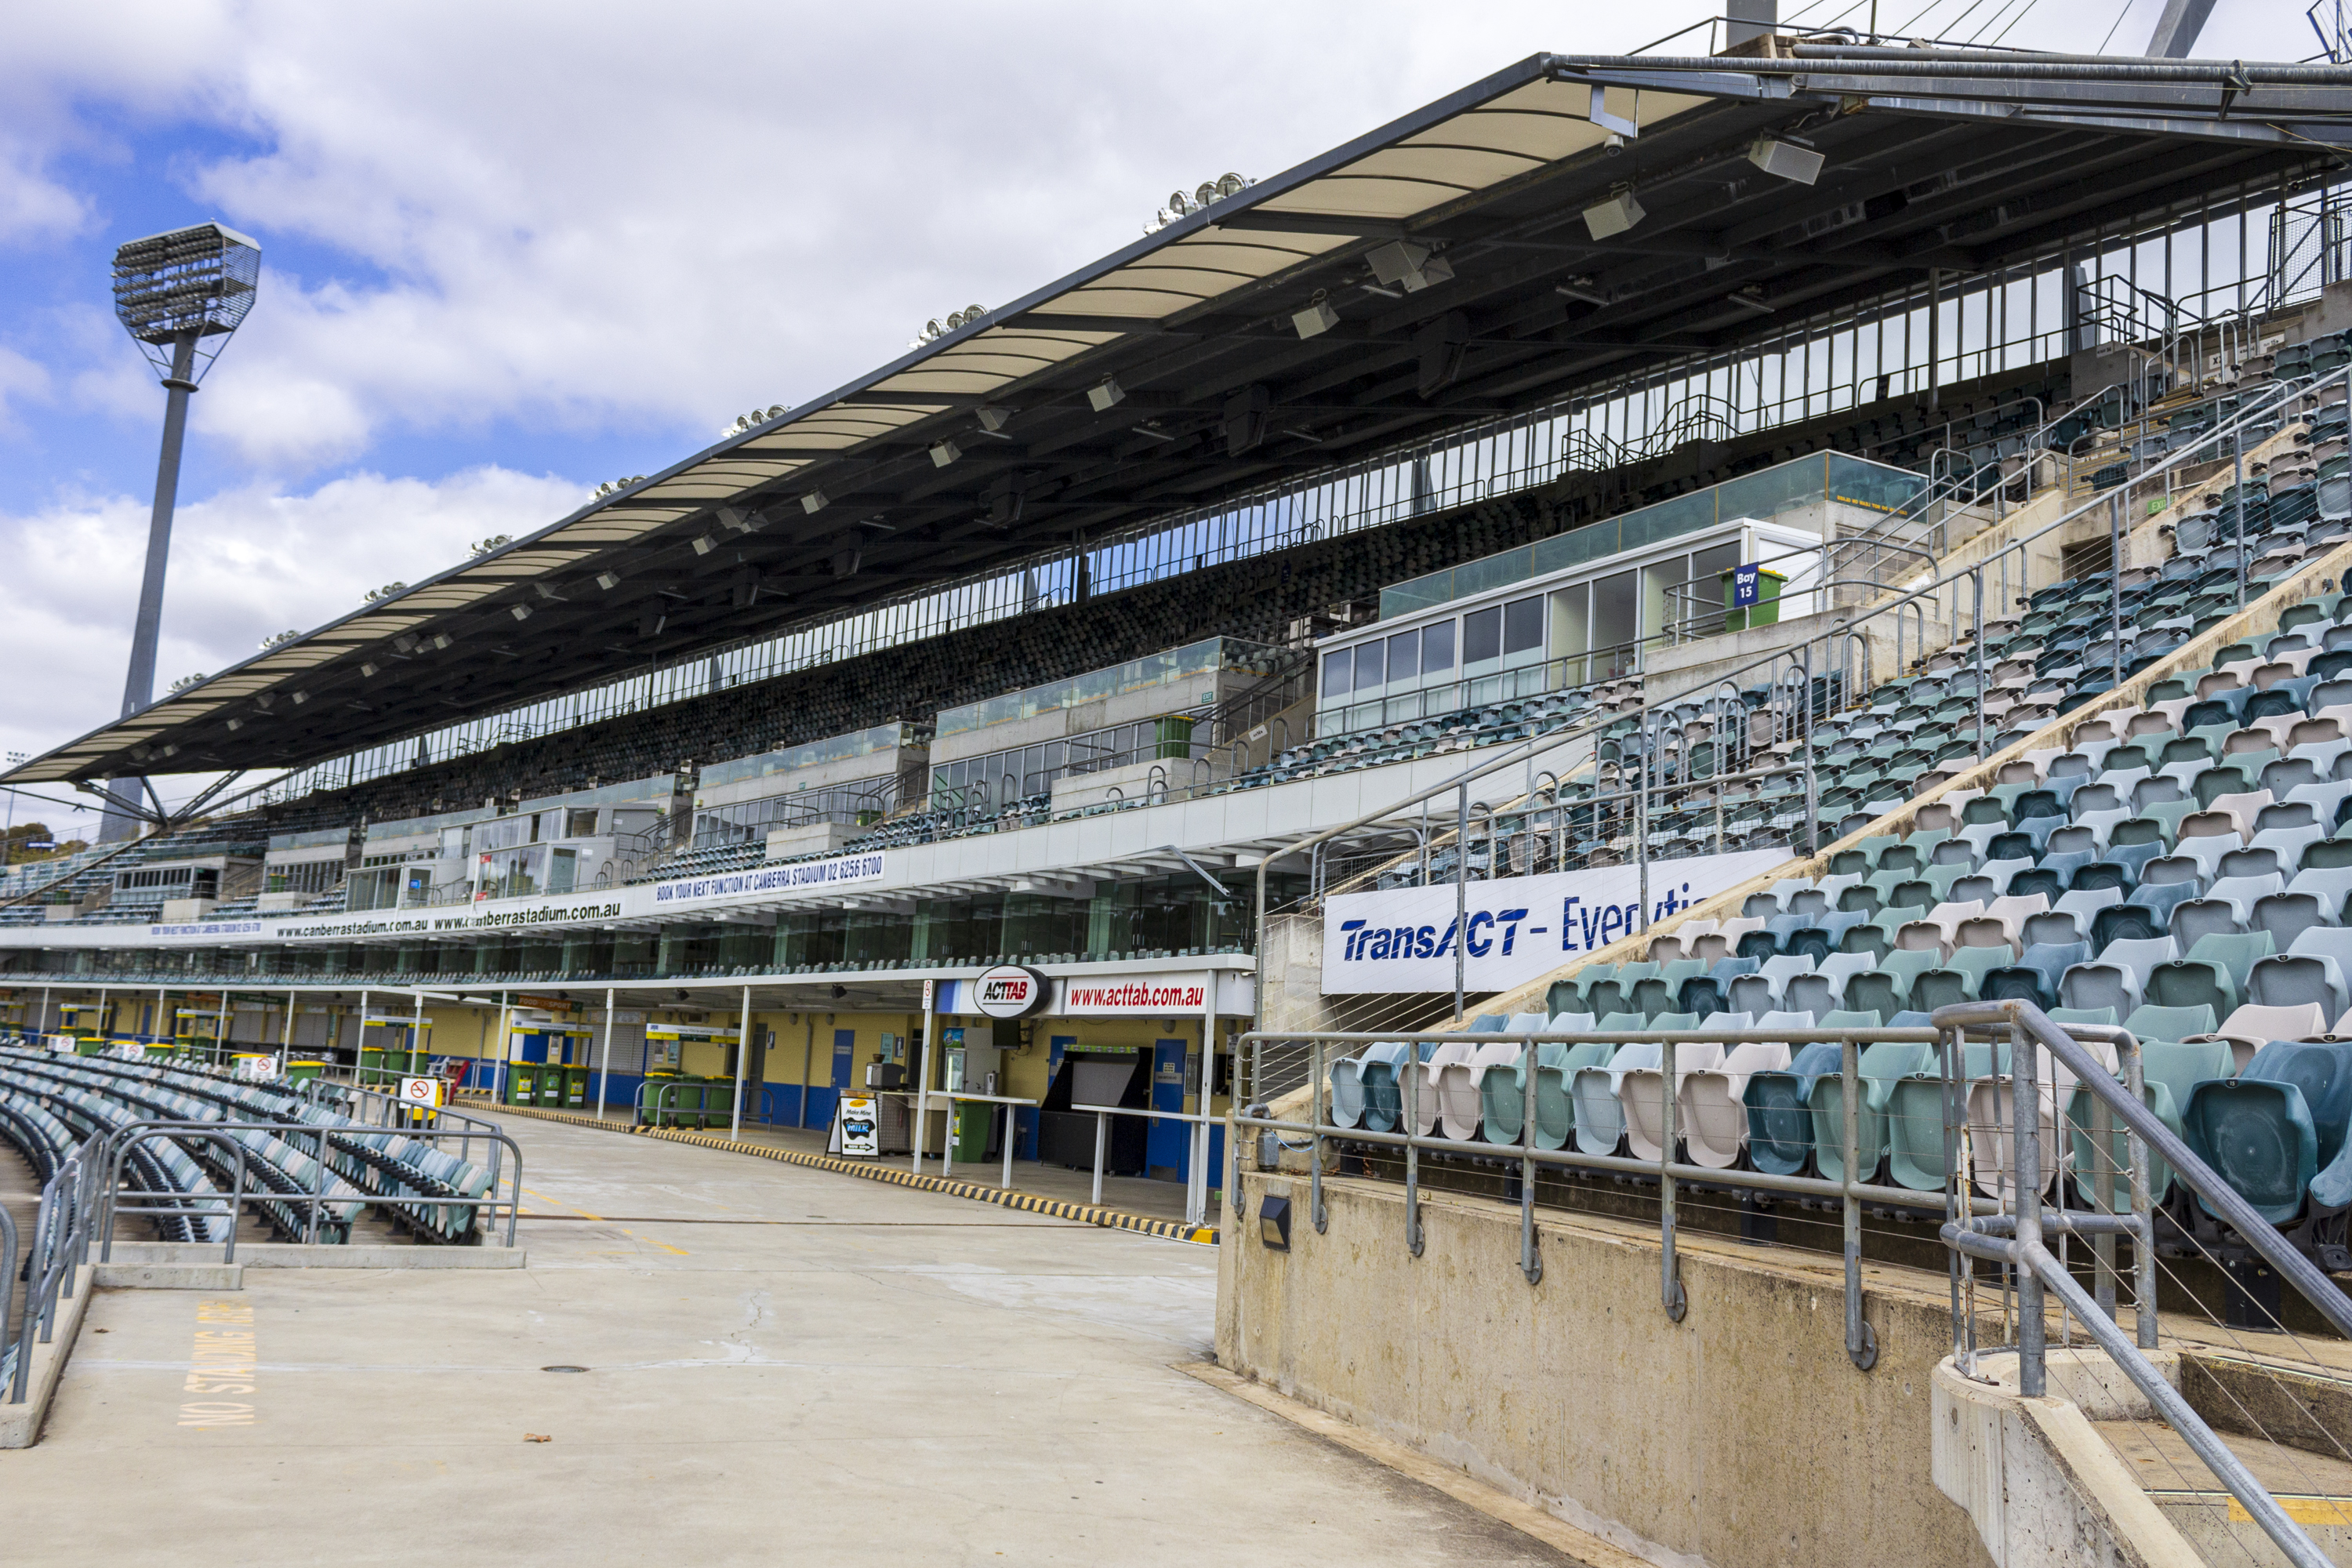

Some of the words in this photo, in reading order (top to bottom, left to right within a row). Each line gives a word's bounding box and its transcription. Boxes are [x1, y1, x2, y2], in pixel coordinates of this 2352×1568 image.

[2152, 499, 2169, 510] EXI
[1737, 572, 1755, 584] Bay
[1740, 586, 1752, 598] 15
[657, 885, 673, 902] BOOK
[676, 883, 691, 898] YOUR
[693, 880, 710, 897] NEXT
[711, 876, 743, 895] FUNCTION
[745, 875, 753, 891] AT
[753, 869, 789, 891] CANBERRA
[793, 865, 826, 885] STADIUM
[828, 863, 837, 881] 02
[840, 859, 860, 879] 6256
[862, 855, 882, 877] 6700
[434, 902, 621, 931] www.cnberrastadium.com.au
[278, 920, 428, 938] www.canberrastadium.com.au
[1340, 908, 1528, 962] TransACT
[983, 982, 1028, 1000] ACTTAB
[1071, 982, 1204, 1006] www.acttab.com.au
[183, 1331, 258, 1394] STANDING
[176, 1401, 256, 1425] NO
